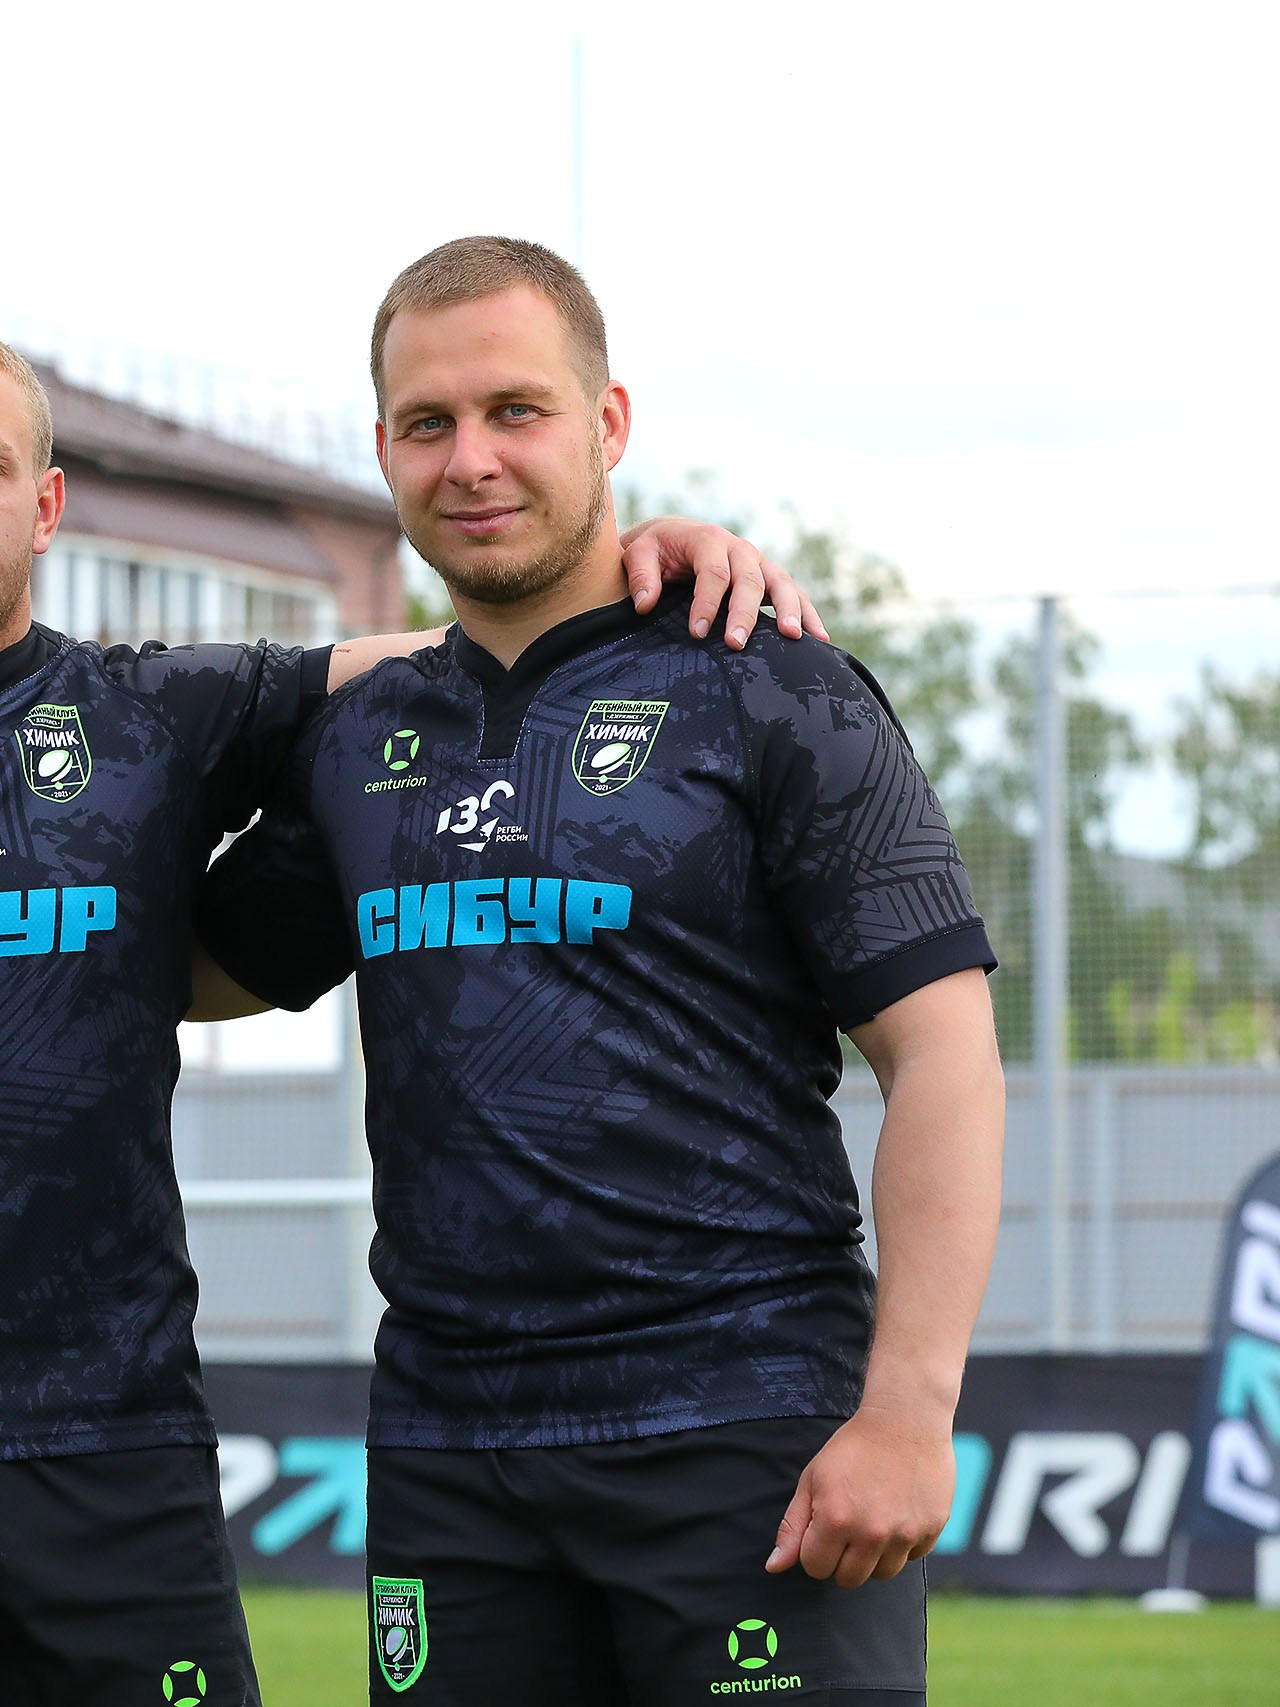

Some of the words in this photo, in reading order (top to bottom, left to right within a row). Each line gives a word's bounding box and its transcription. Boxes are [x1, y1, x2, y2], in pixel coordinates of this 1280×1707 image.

[57, 709, 76, 718] КЛУБ
[592, 702, 642, 712] РЕГБИЙНЫЙ
[642, 704, 666, 712] КЛУБ
[22, 729, 80, 748] ХИМИК
[584, 724, 652, 741] ХИМИК
[364, 774, 428, 793] centurion
[54, 790, 69, 798] 2021
[497, 826, 522, 835] РЕГБИ
[495, 833, 528, 842] РОССИИ
[357, 877, 633, 960] СИБУР
[400, 1585, 418, 1594] КЛУБ
[378, 1607, 415, 1626] ХИМИК
[710, 1672, 802, 1696] centurion
